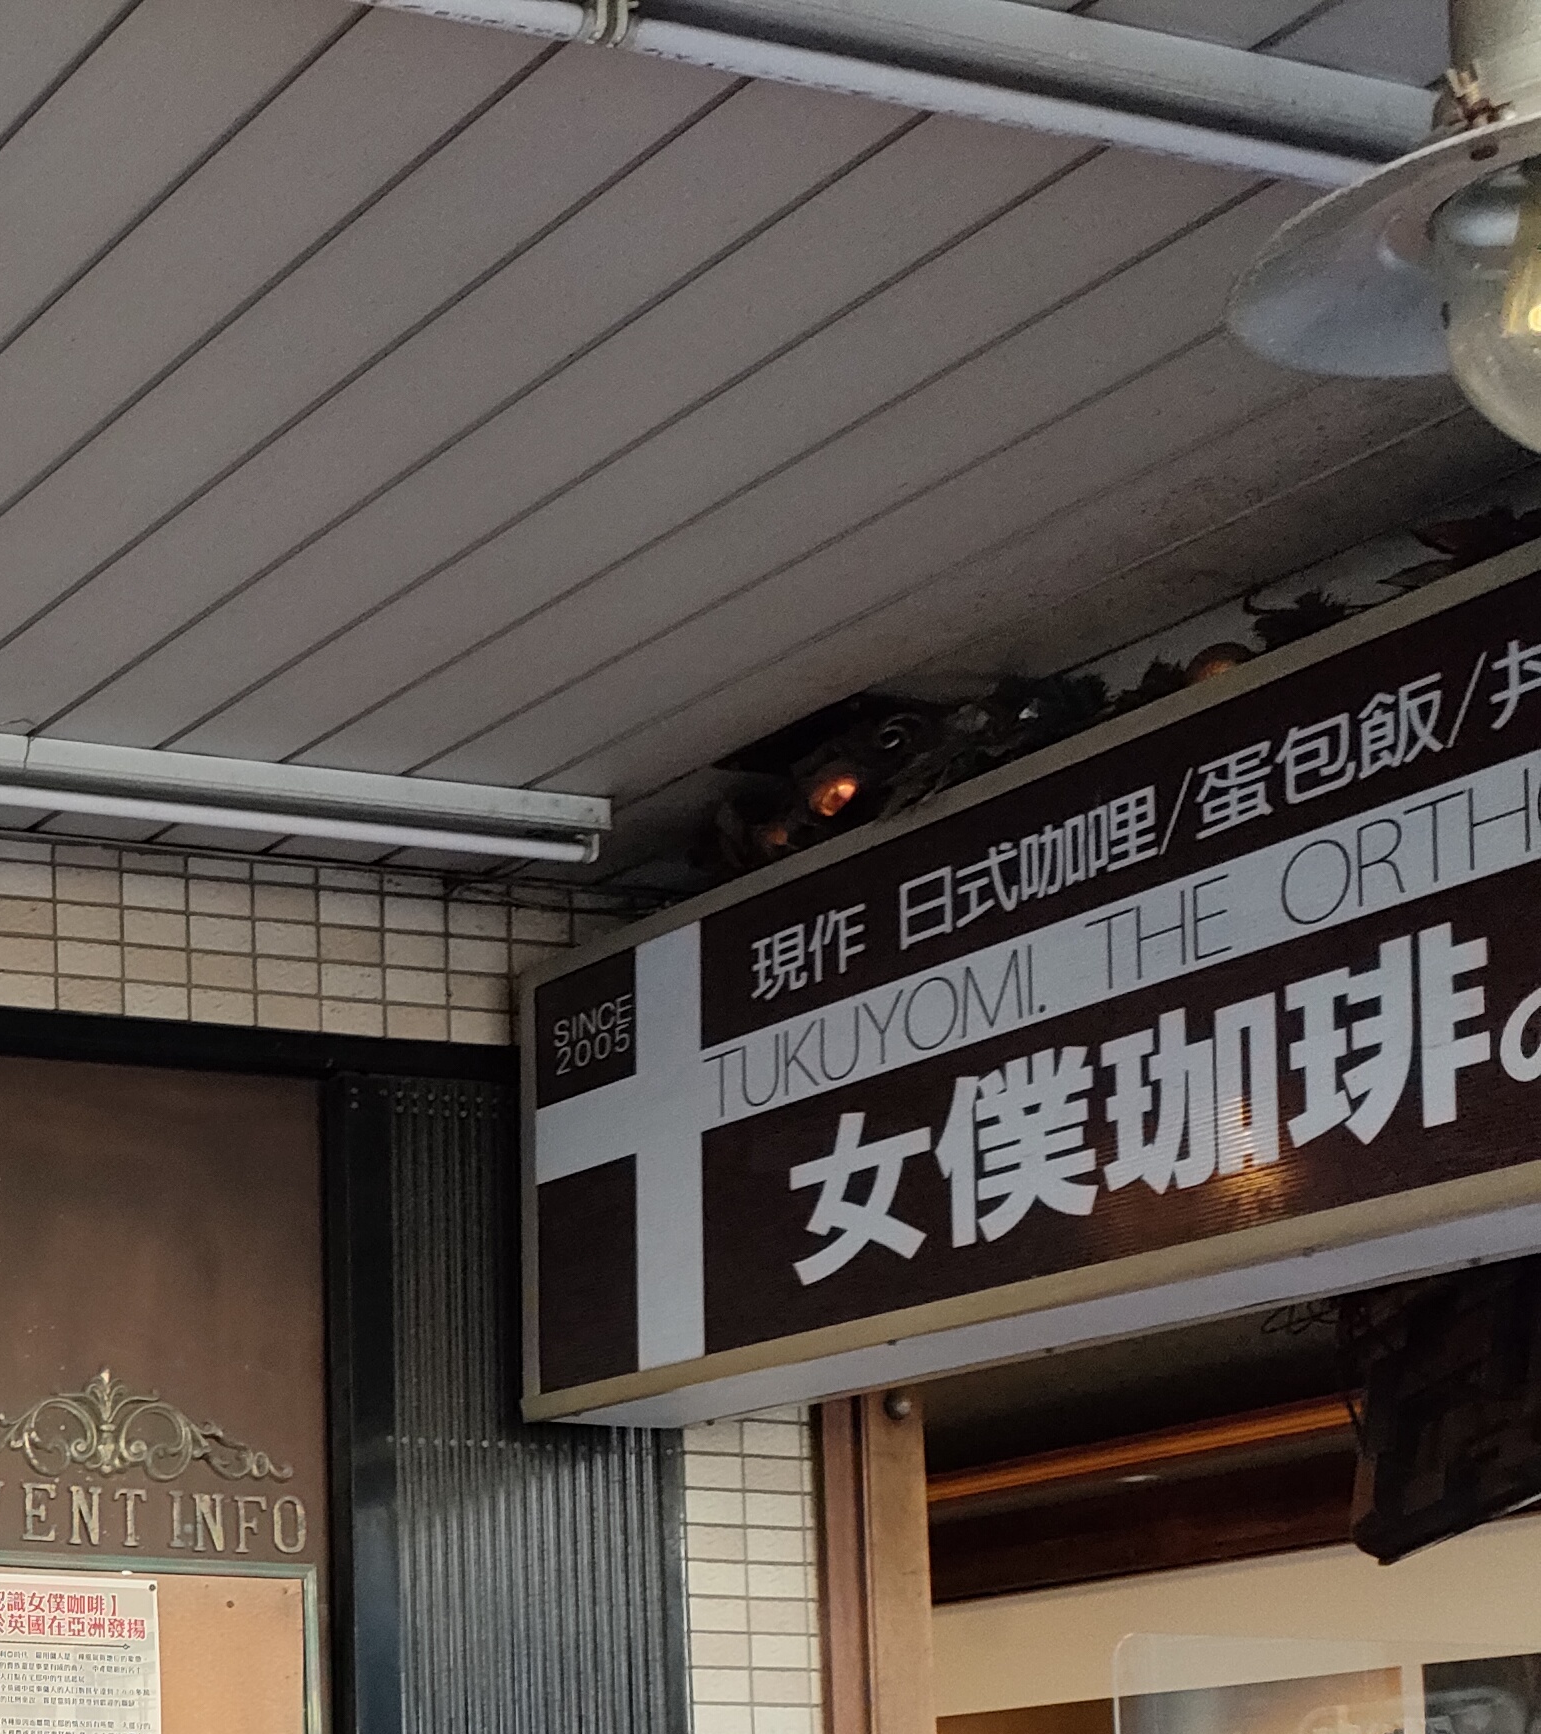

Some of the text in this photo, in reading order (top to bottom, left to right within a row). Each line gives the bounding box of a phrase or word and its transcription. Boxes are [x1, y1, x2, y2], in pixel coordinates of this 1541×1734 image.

[704, 768, 1541, 1117] TUKUYOMI. THE ORTH
[750, 904, 865, 1001] 現作
[554, 993, 633, 1052] SINCE
[555, 1026, 632, 1076] 2005
[169, 1490, 308, 1555] INFO
